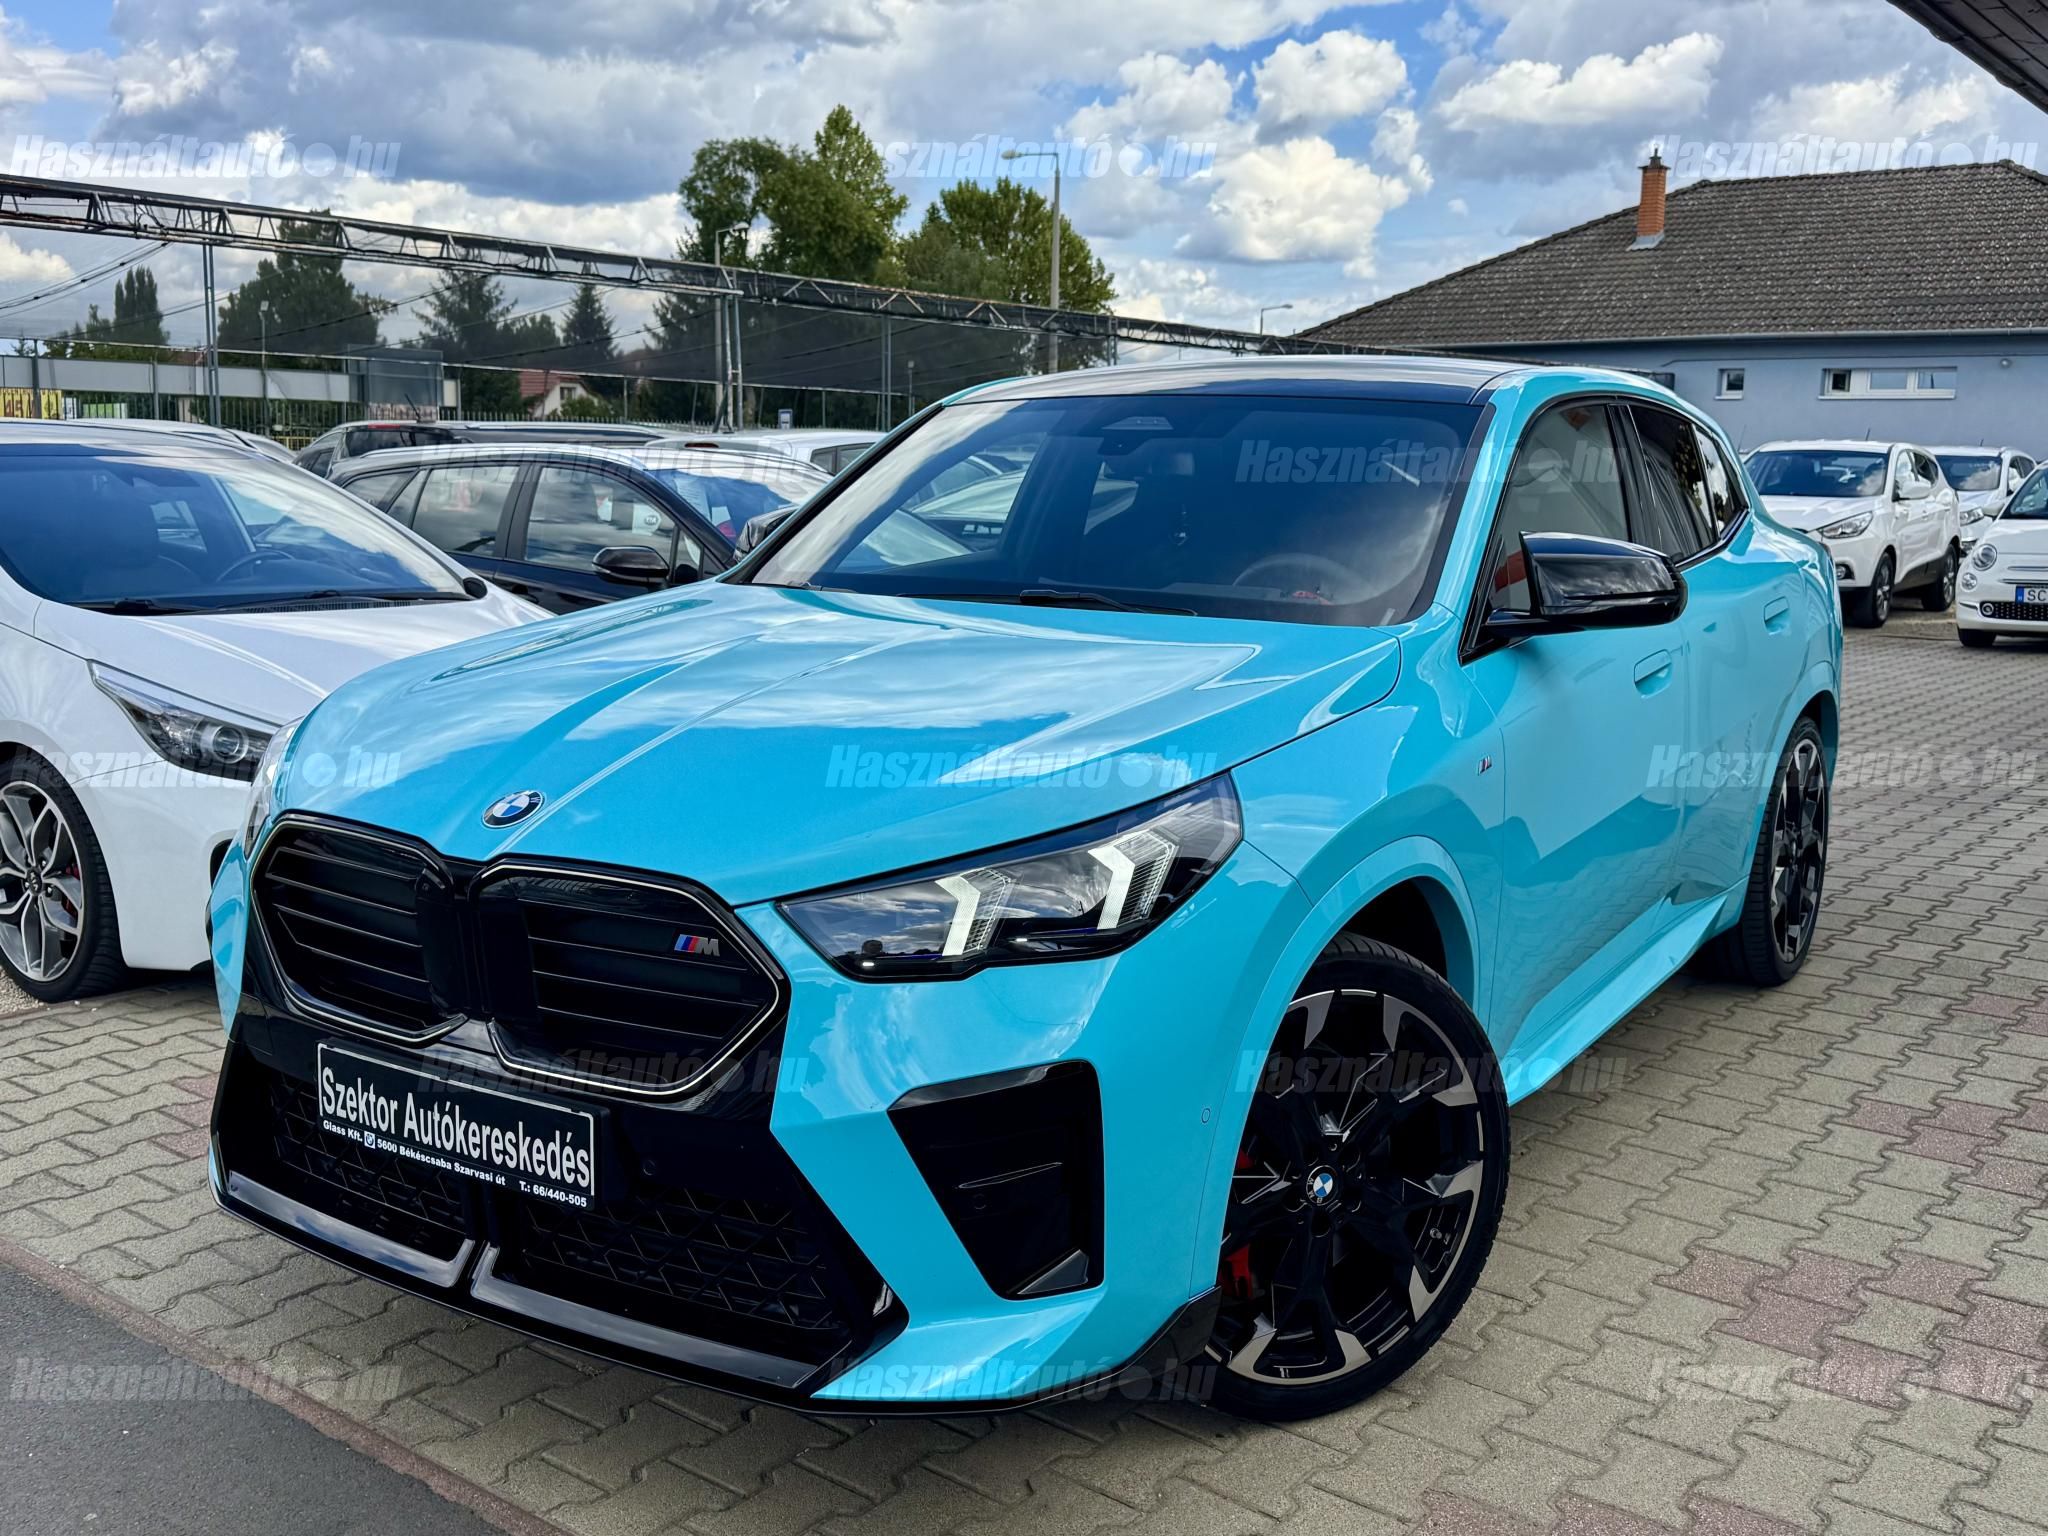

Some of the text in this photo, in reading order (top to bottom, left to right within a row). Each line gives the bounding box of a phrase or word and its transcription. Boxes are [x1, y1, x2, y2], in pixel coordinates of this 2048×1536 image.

[322, 1066, 590, 1188] Szektor Autókereskedés
[323, 1120, 347, 1136] Glass
[347, 1127, 363, 1142] Kft.
[376, 1139, 398, 1153] 5600
[399, 1145, 452, 1170] Békéscsaba
[453, 1162, 494, 1184] Szarvasi
[495, 1170, 506, 1186] út
[532, 1185, 587, 1208] 66/440-505
